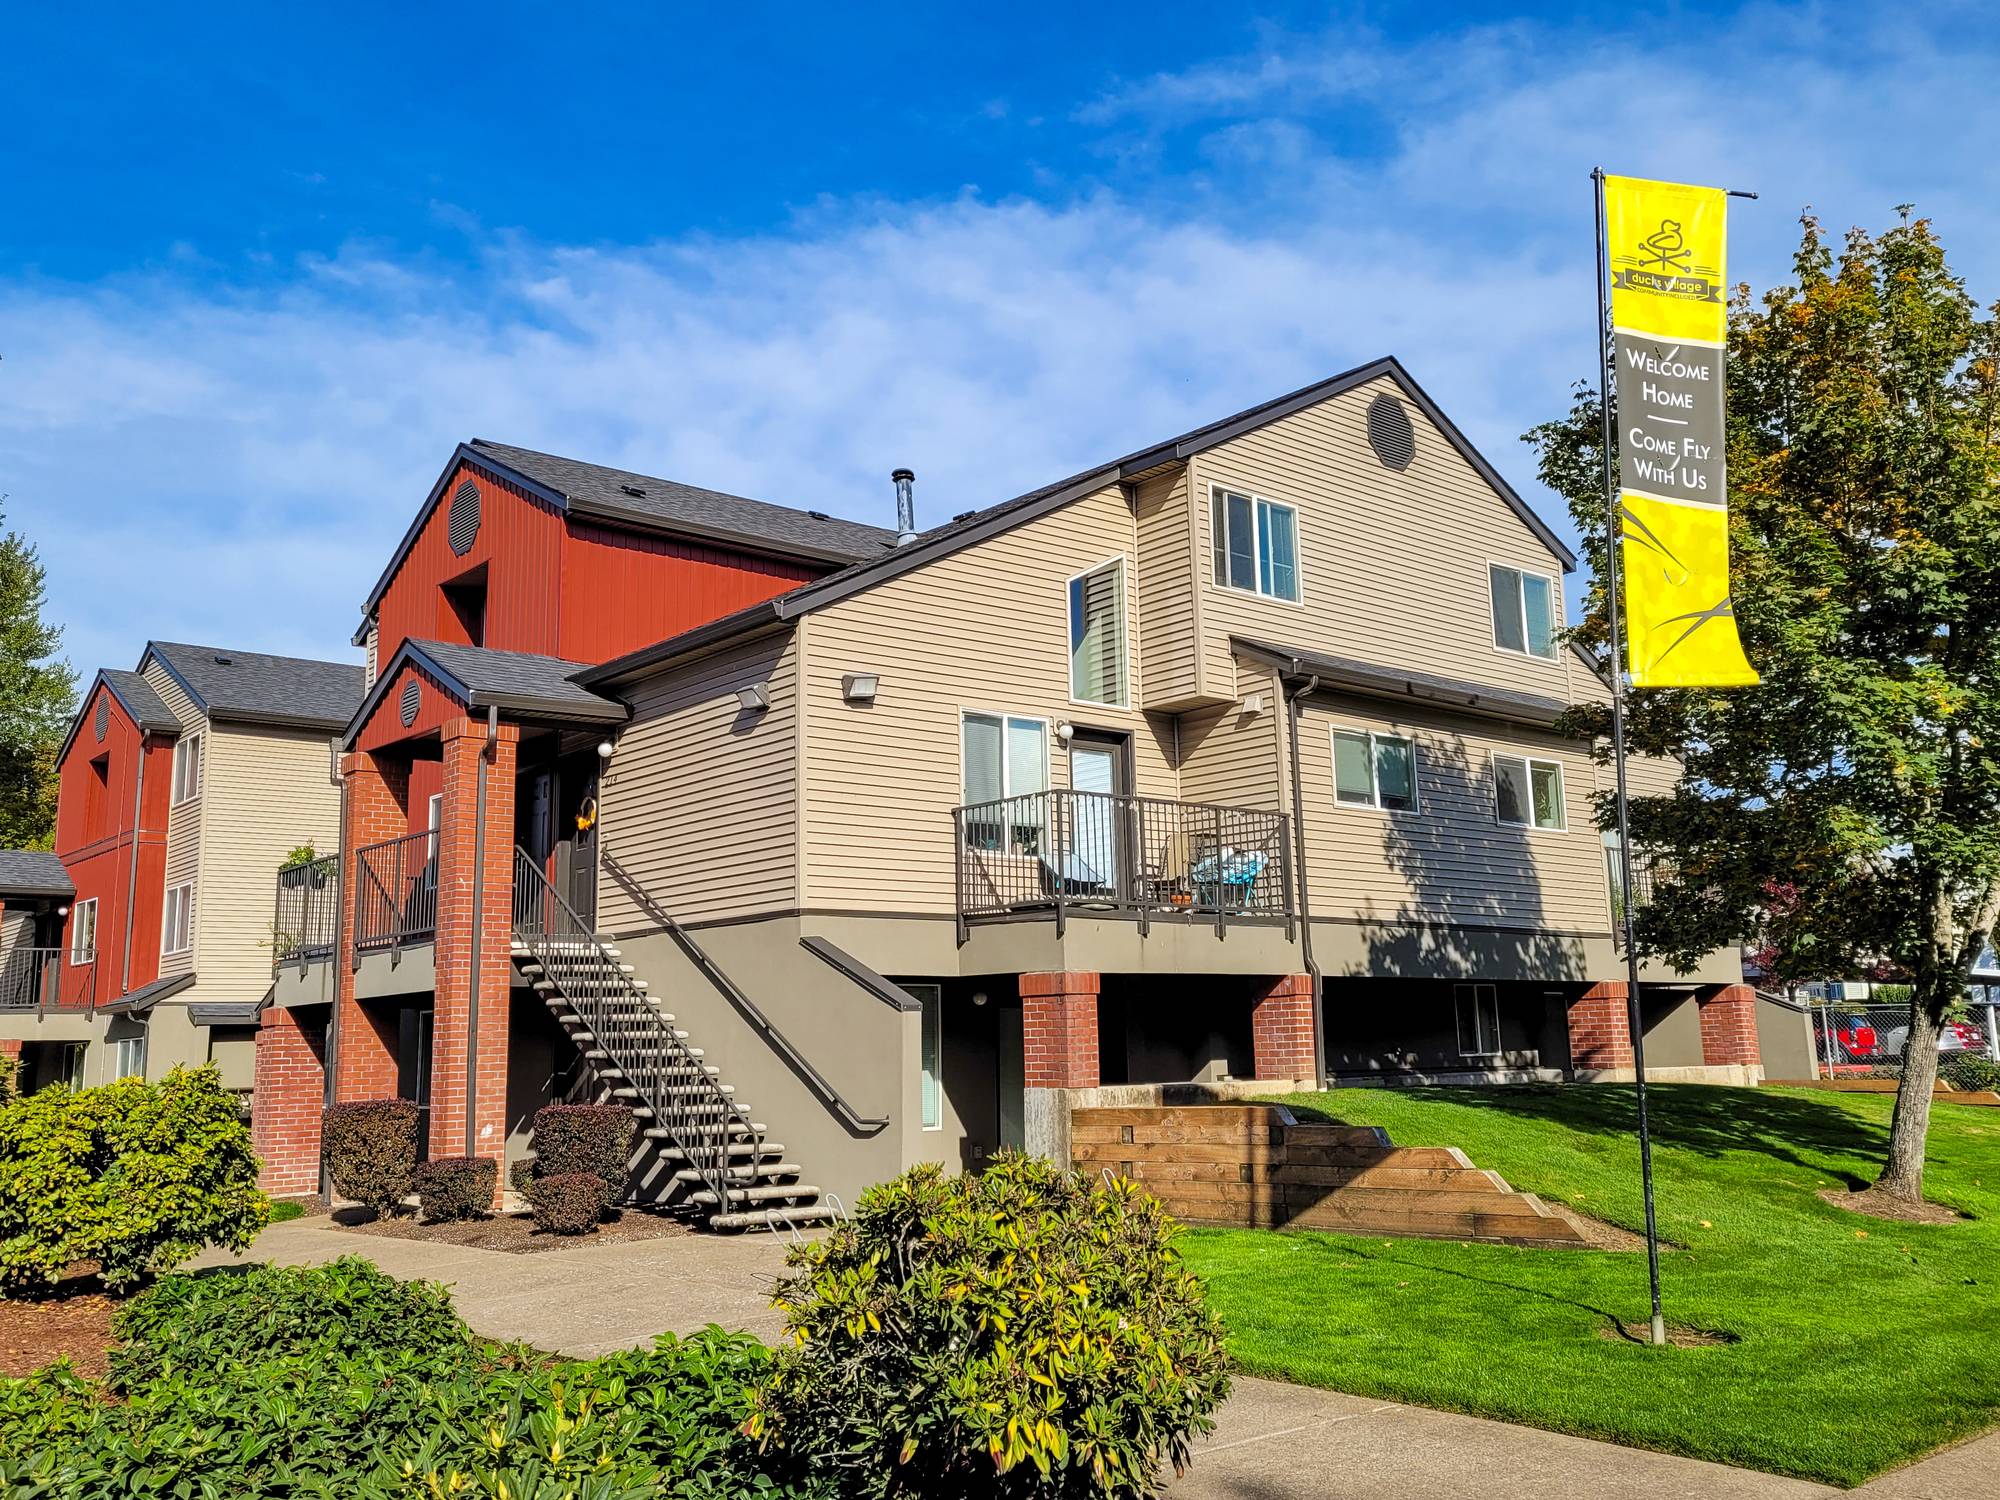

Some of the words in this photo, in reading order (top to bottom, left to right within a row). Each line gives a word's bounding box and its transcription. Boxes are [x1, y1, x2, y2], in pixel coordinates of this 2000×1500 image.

[1626, 348, 1709, 381] WELCOME
[1642, 381, 1693, 408] HOME
[1629, 427, 1676, 455] COME
[1683, 438, 1711, 460] FLY
[1633, 457, 1675, 486] WITH
[1682, 467, 1707, 490] US
